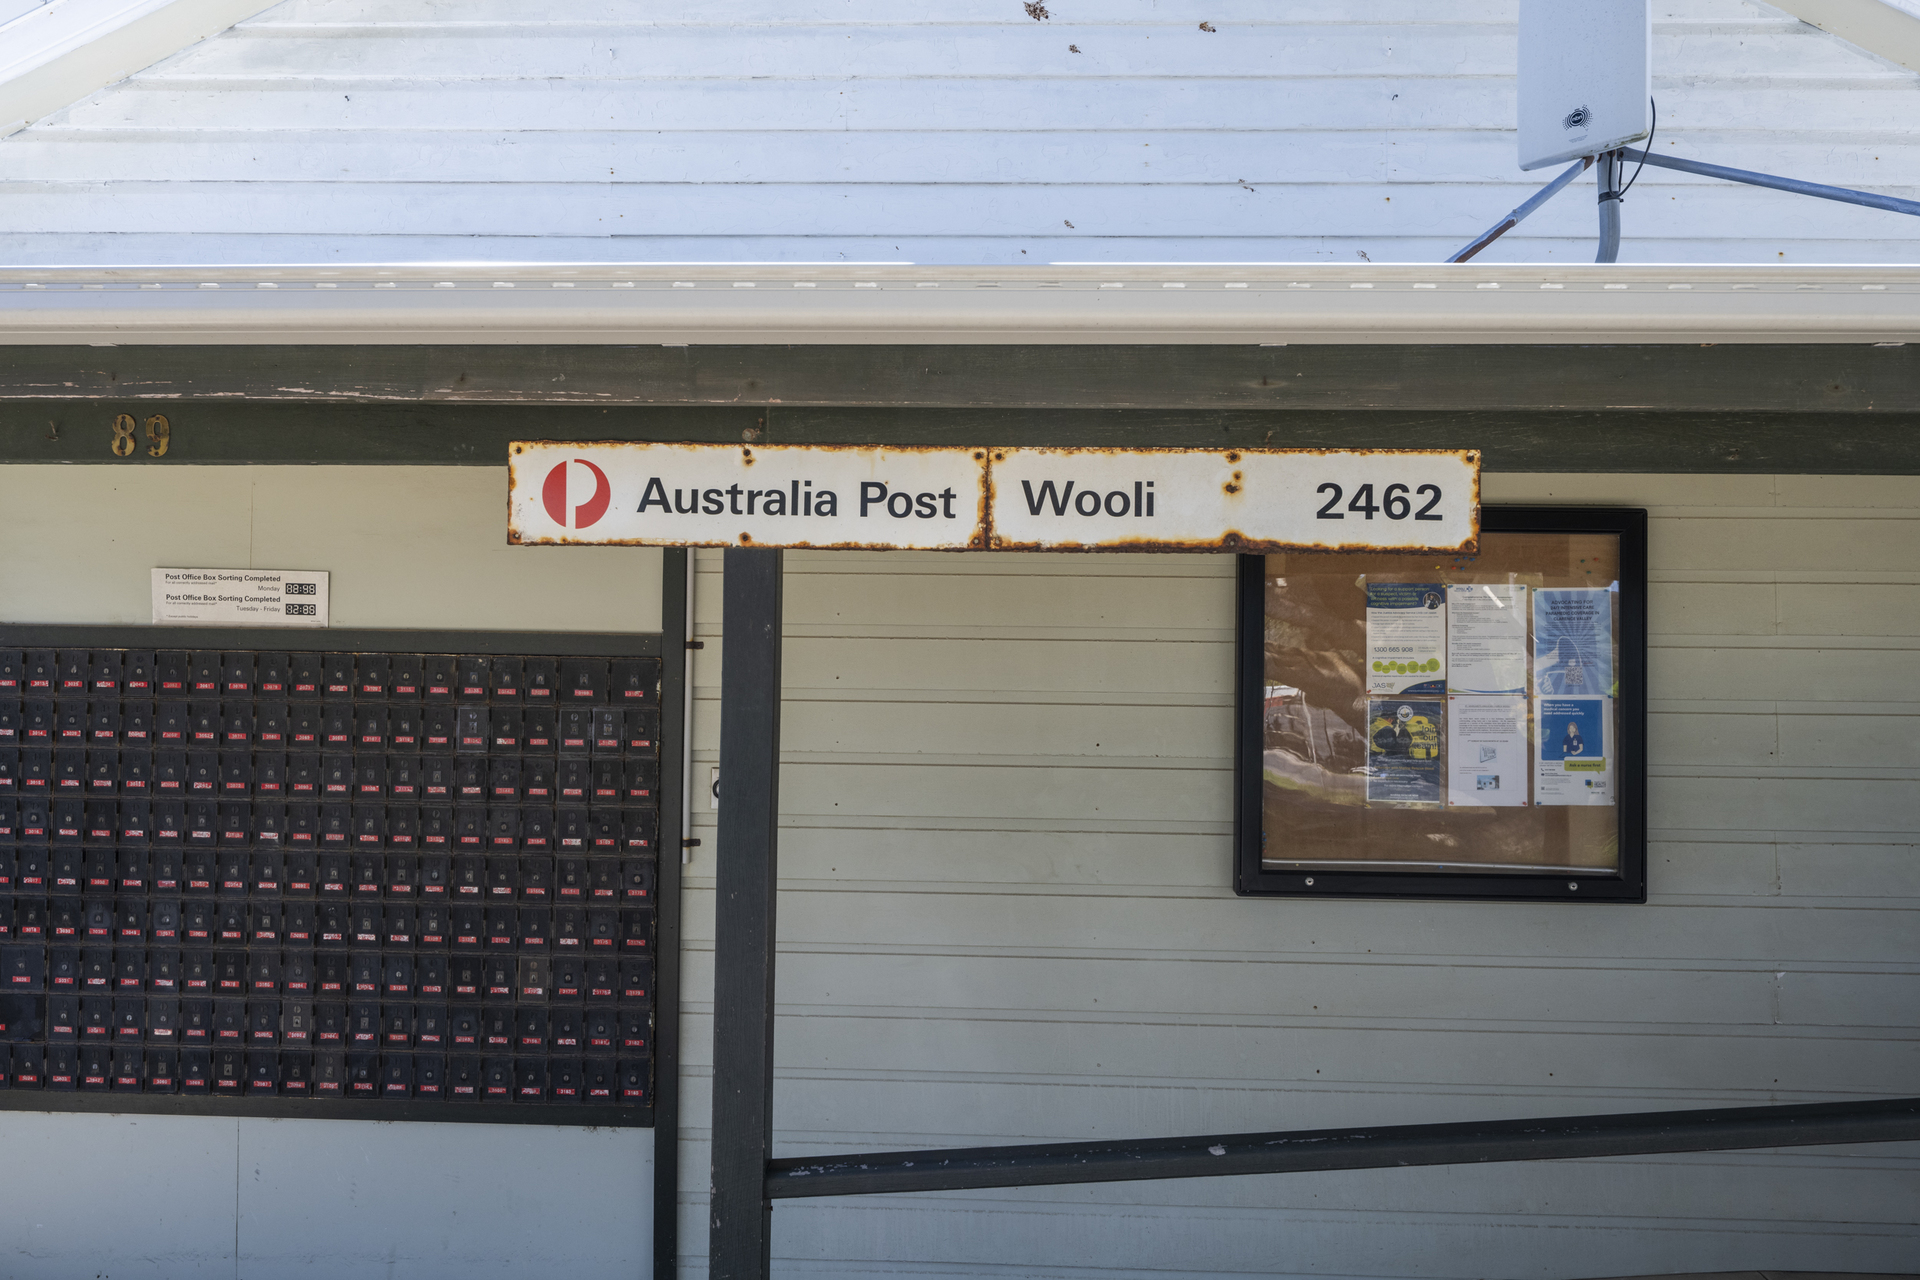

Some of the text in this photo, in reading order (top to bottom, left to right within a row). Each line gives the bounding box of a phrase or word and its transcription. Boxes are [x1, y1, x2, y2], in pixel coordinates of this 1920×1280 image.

[111, 412, 170, 457] 89
[636, 477, 957, 519] Australia Post
[1021, 479, 1444, 521] Wooli 2462
[218, 574, 243, 582] Sorting
[244, 575, 281, 583] Completed
[218, 595, 243, 603] Sorting
[244, 596, 281, 604] Completed
